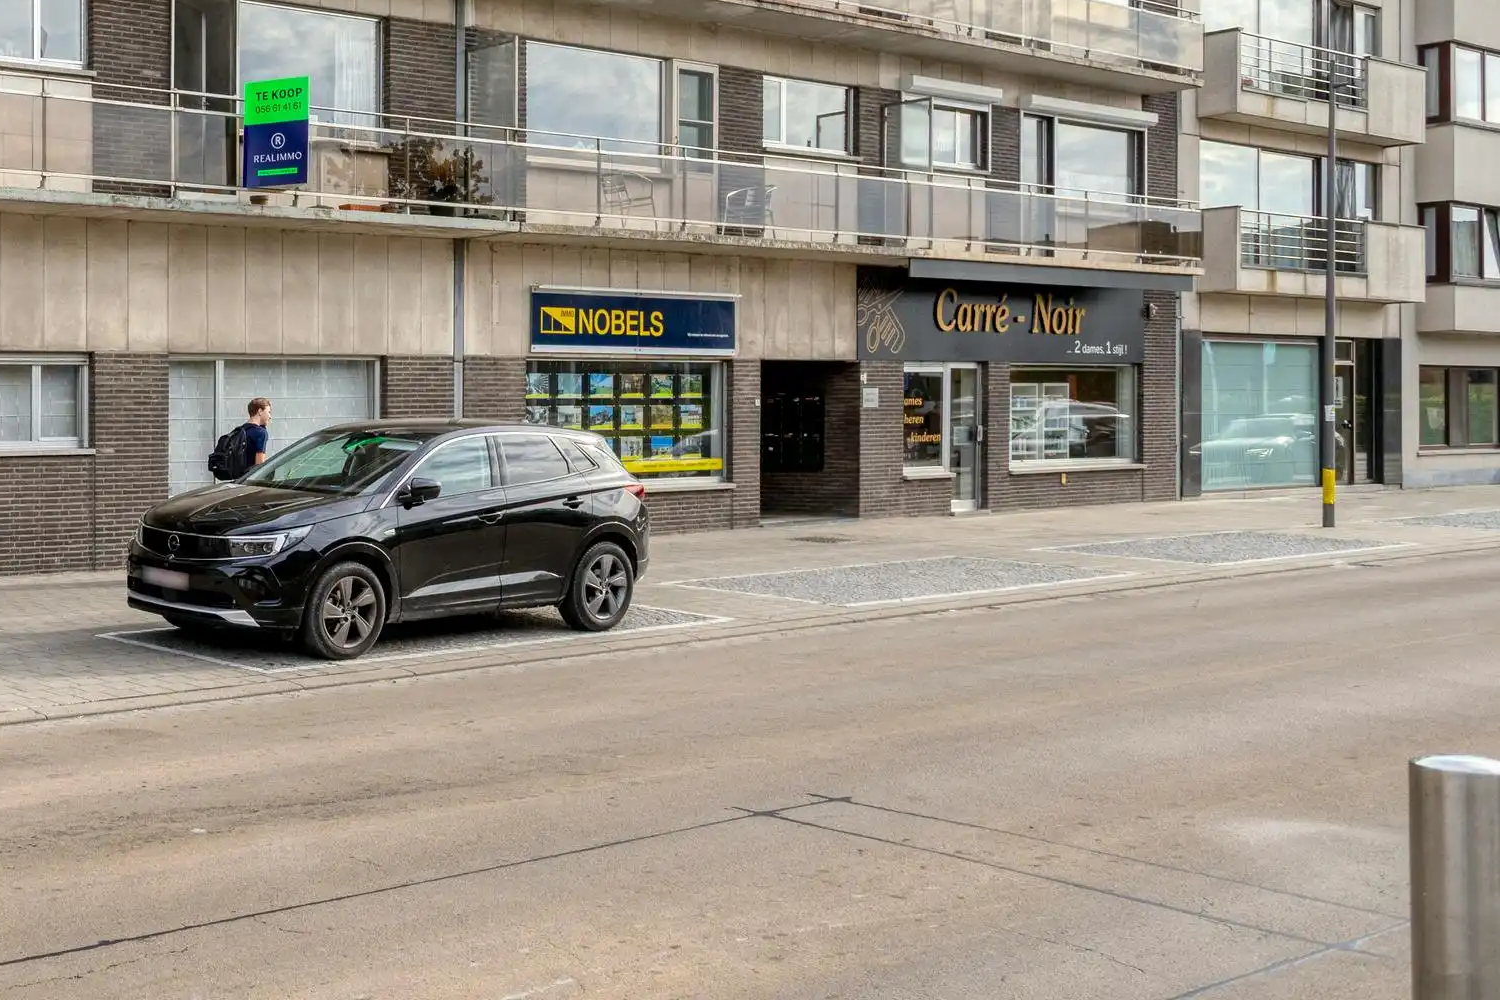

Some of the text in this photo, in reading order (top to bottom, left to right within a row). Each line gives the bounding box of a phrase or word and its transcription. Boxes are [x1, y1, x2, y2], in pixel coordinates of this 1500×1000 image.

[256, 88, 303, 101] TE KOOP
[255, 101, 302, 114] 056 61 41 61
[253, 151, 302, 163] REALIMMO
[936, 287, 1010, 332] Carré
[1032, 292, 1086, 335] Noir
[579, 308, 664, 337] NOBELS
[1074, 340, 1081, 353] 2
[1106, 340, 1111, 354] 1
[903, 413, 924, 424] heren
